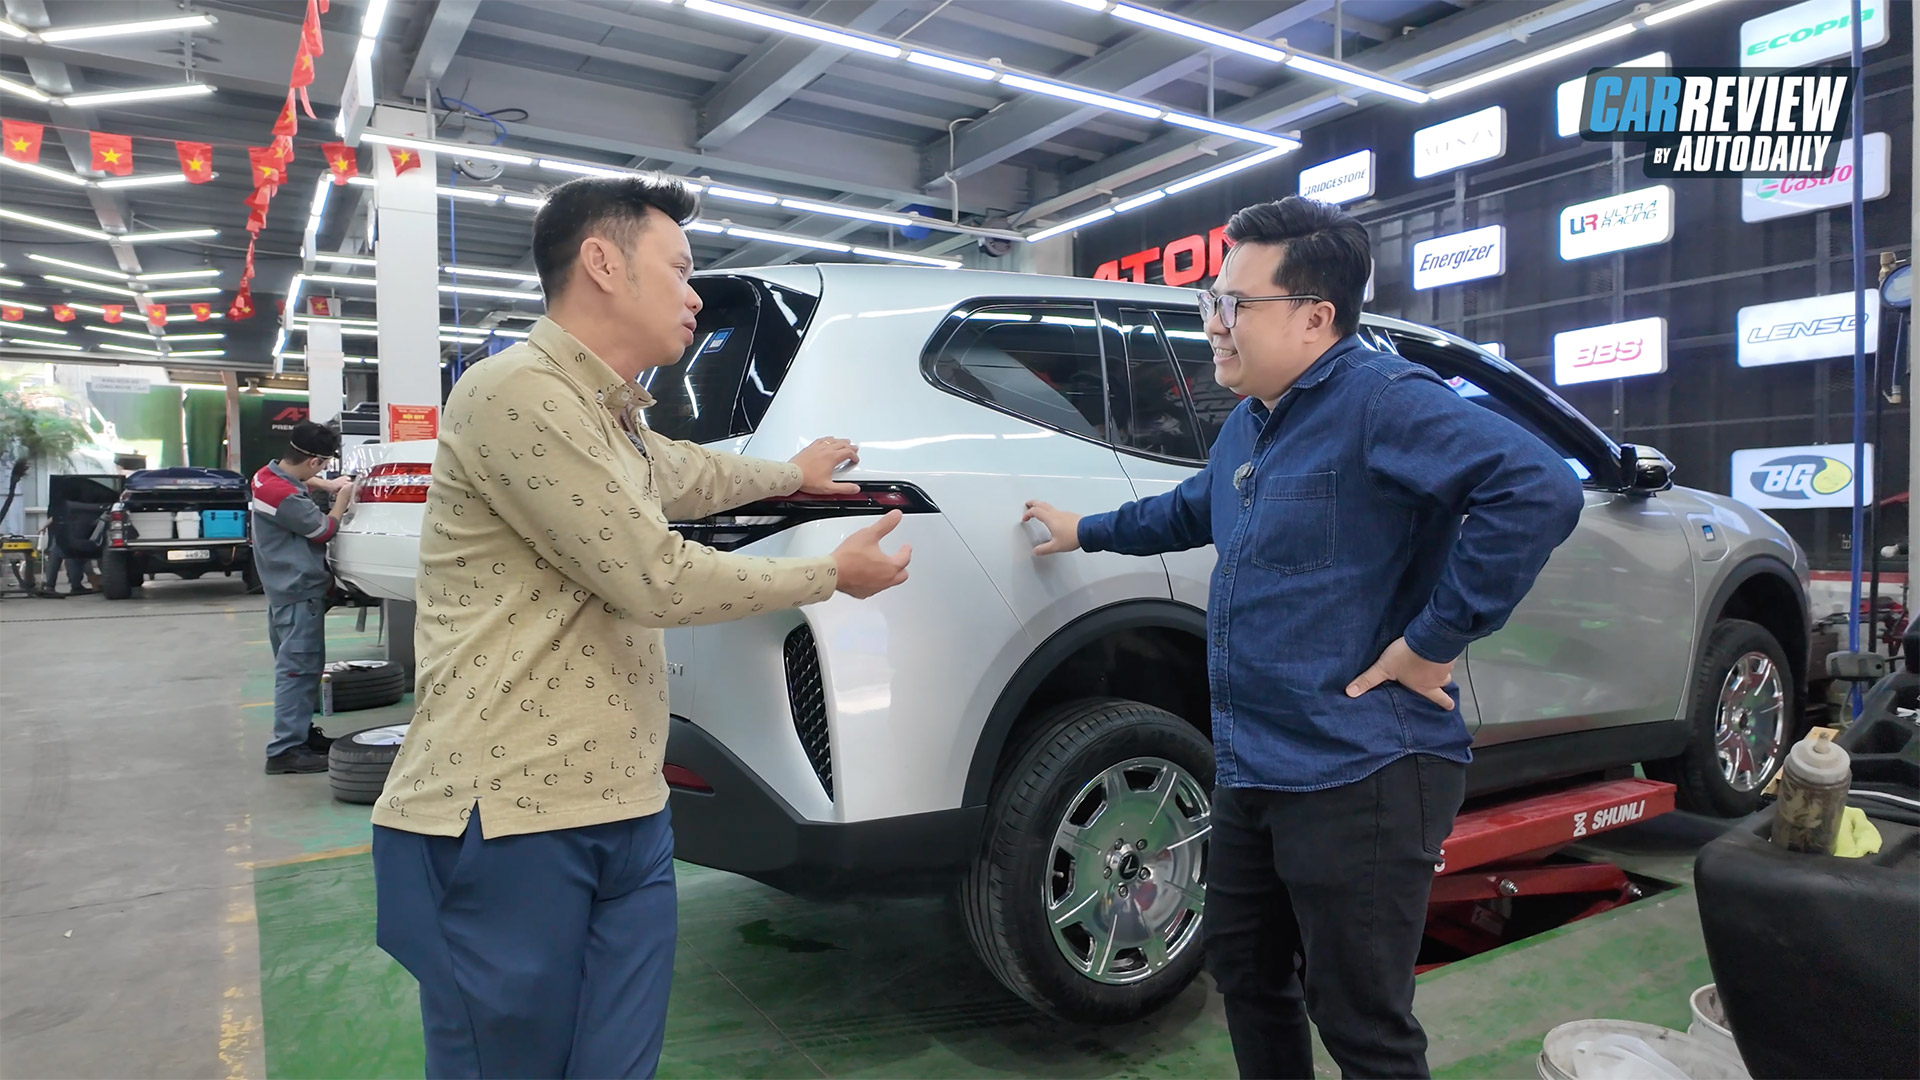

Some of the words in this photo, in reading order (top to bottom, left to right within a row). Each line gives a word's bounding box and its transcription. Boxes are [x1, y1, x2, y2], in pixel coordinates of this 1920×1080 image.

[1304, 169, 1367, 197] BRIDGESTONE
[1780, 165, 1853, 194] Castro
[1601, 209, 1657, 229] RACING
[1604, 200, 1657, 219] ULTRA
[1419, 243, 1495, 272] Energizer
[1573, 337, 1643, 368] BBS
[1755, 464, 1817, 500] BG
[1592, 800, 1645, 830] SHUNLI
